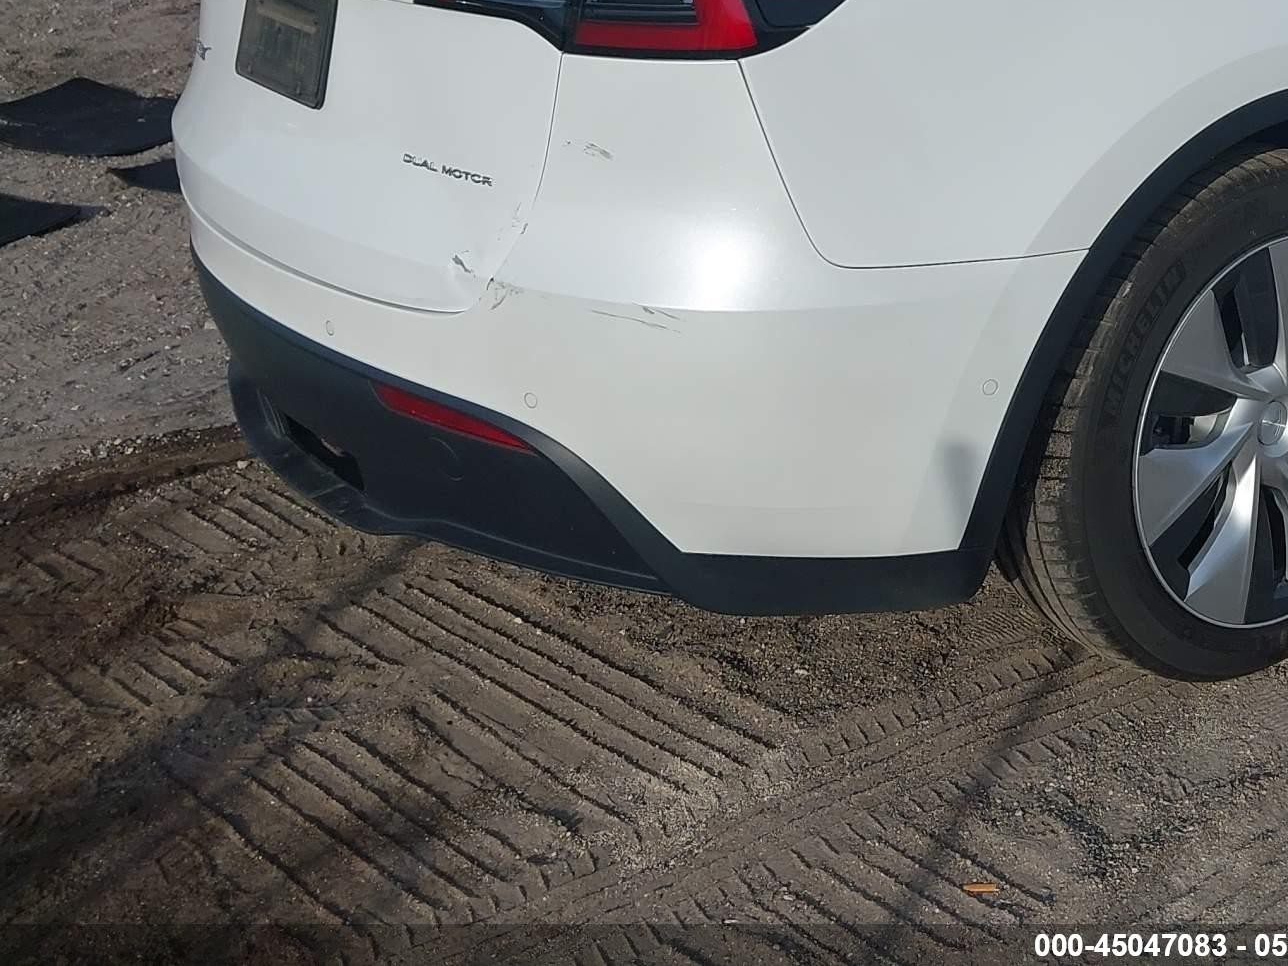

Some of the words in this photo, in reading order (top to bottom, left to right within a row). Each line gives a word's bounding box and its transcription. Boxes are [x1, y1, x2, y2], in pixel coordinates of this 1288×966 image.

[402, 153, 438, 172] DUAL
[441, 165, 492, 187] MOTOR
[1103, 260, 1187, 416] MICHELIN
